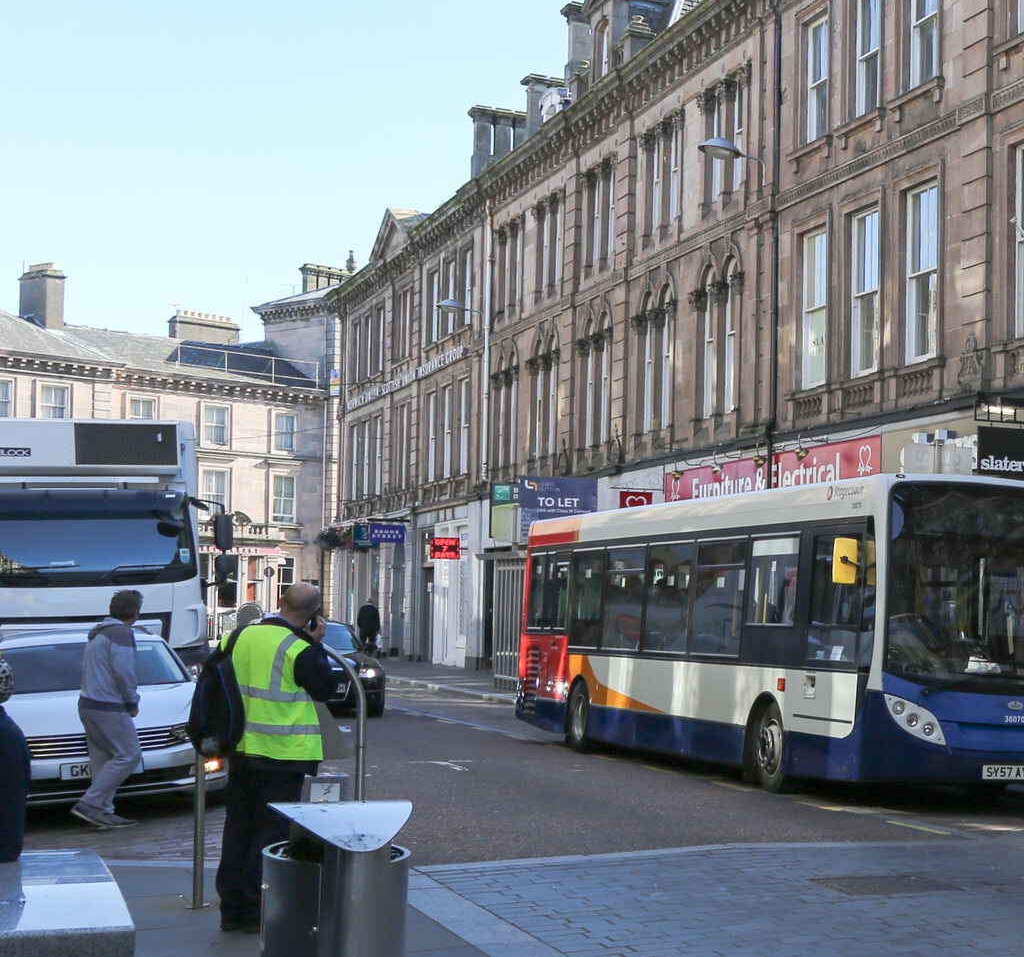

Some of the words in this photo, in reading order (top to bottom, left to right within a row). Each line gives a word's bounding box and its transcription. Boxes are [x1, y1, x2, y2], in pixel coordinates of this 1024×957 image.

[445, 345, 464, 365] GROUP
[692, 473, 752, 499] Furniture
[755, 467, 766, 491] &
[771, 452, 840, 488] Electrical
[834, 484, 865, 500] Stagecoach
[537, 497, 554, 507] TO
[557, 498, 580, 507] LET
[1004, 715, 1024, 723] 36070
[70, 765, 89, 777] GK
[986, 767, 1013, 778] SY57
